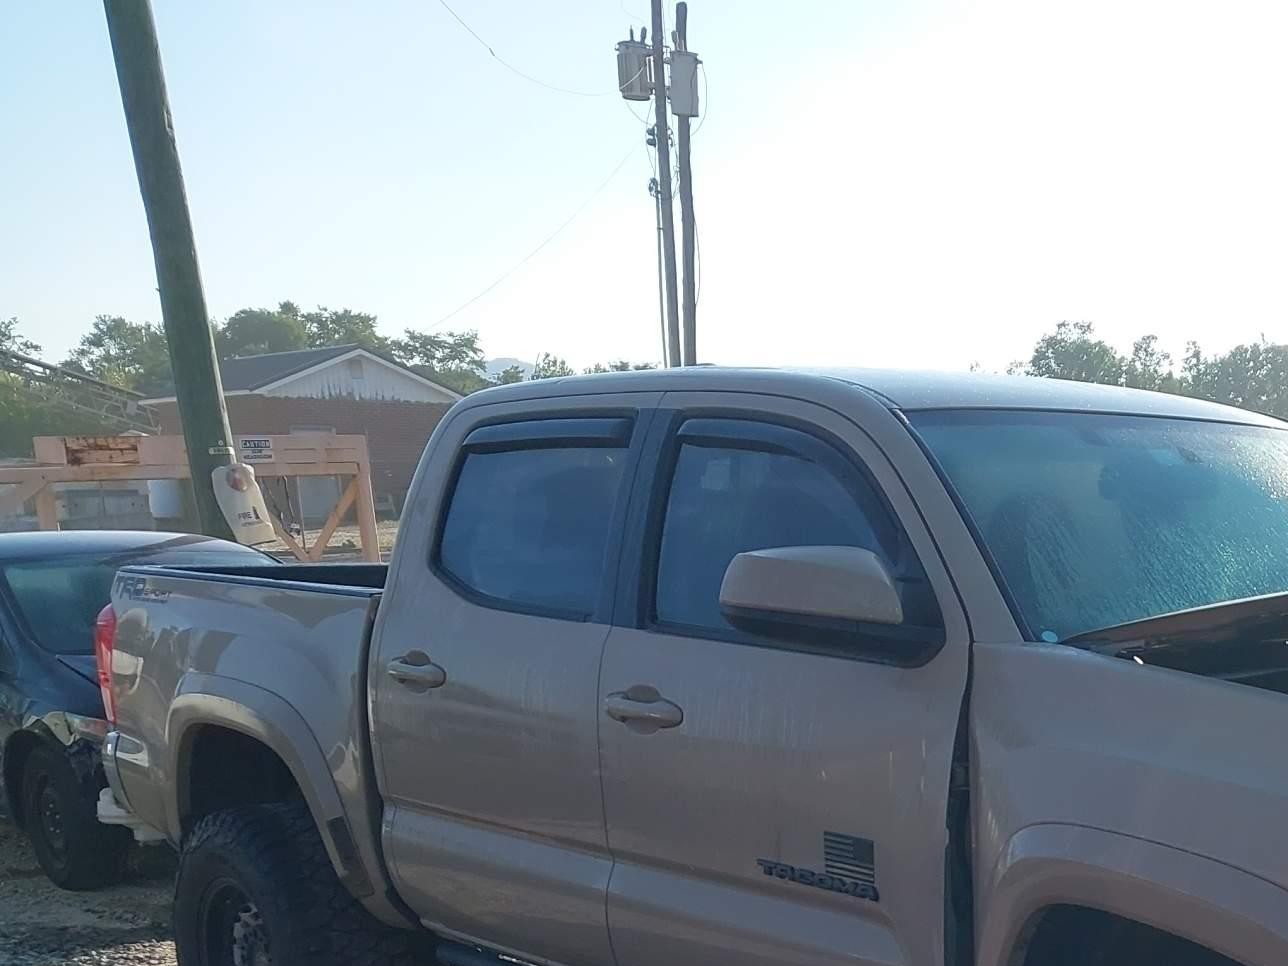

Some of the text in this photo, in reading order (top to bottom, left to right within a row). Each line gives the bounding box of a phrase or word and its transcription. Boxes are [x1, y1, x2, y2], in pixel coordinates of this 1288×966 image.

[241, 440, 270, 448] CAUTION
[116, 575, 145, 601] TRD
[756, 858, 879, 902] TACOMA
